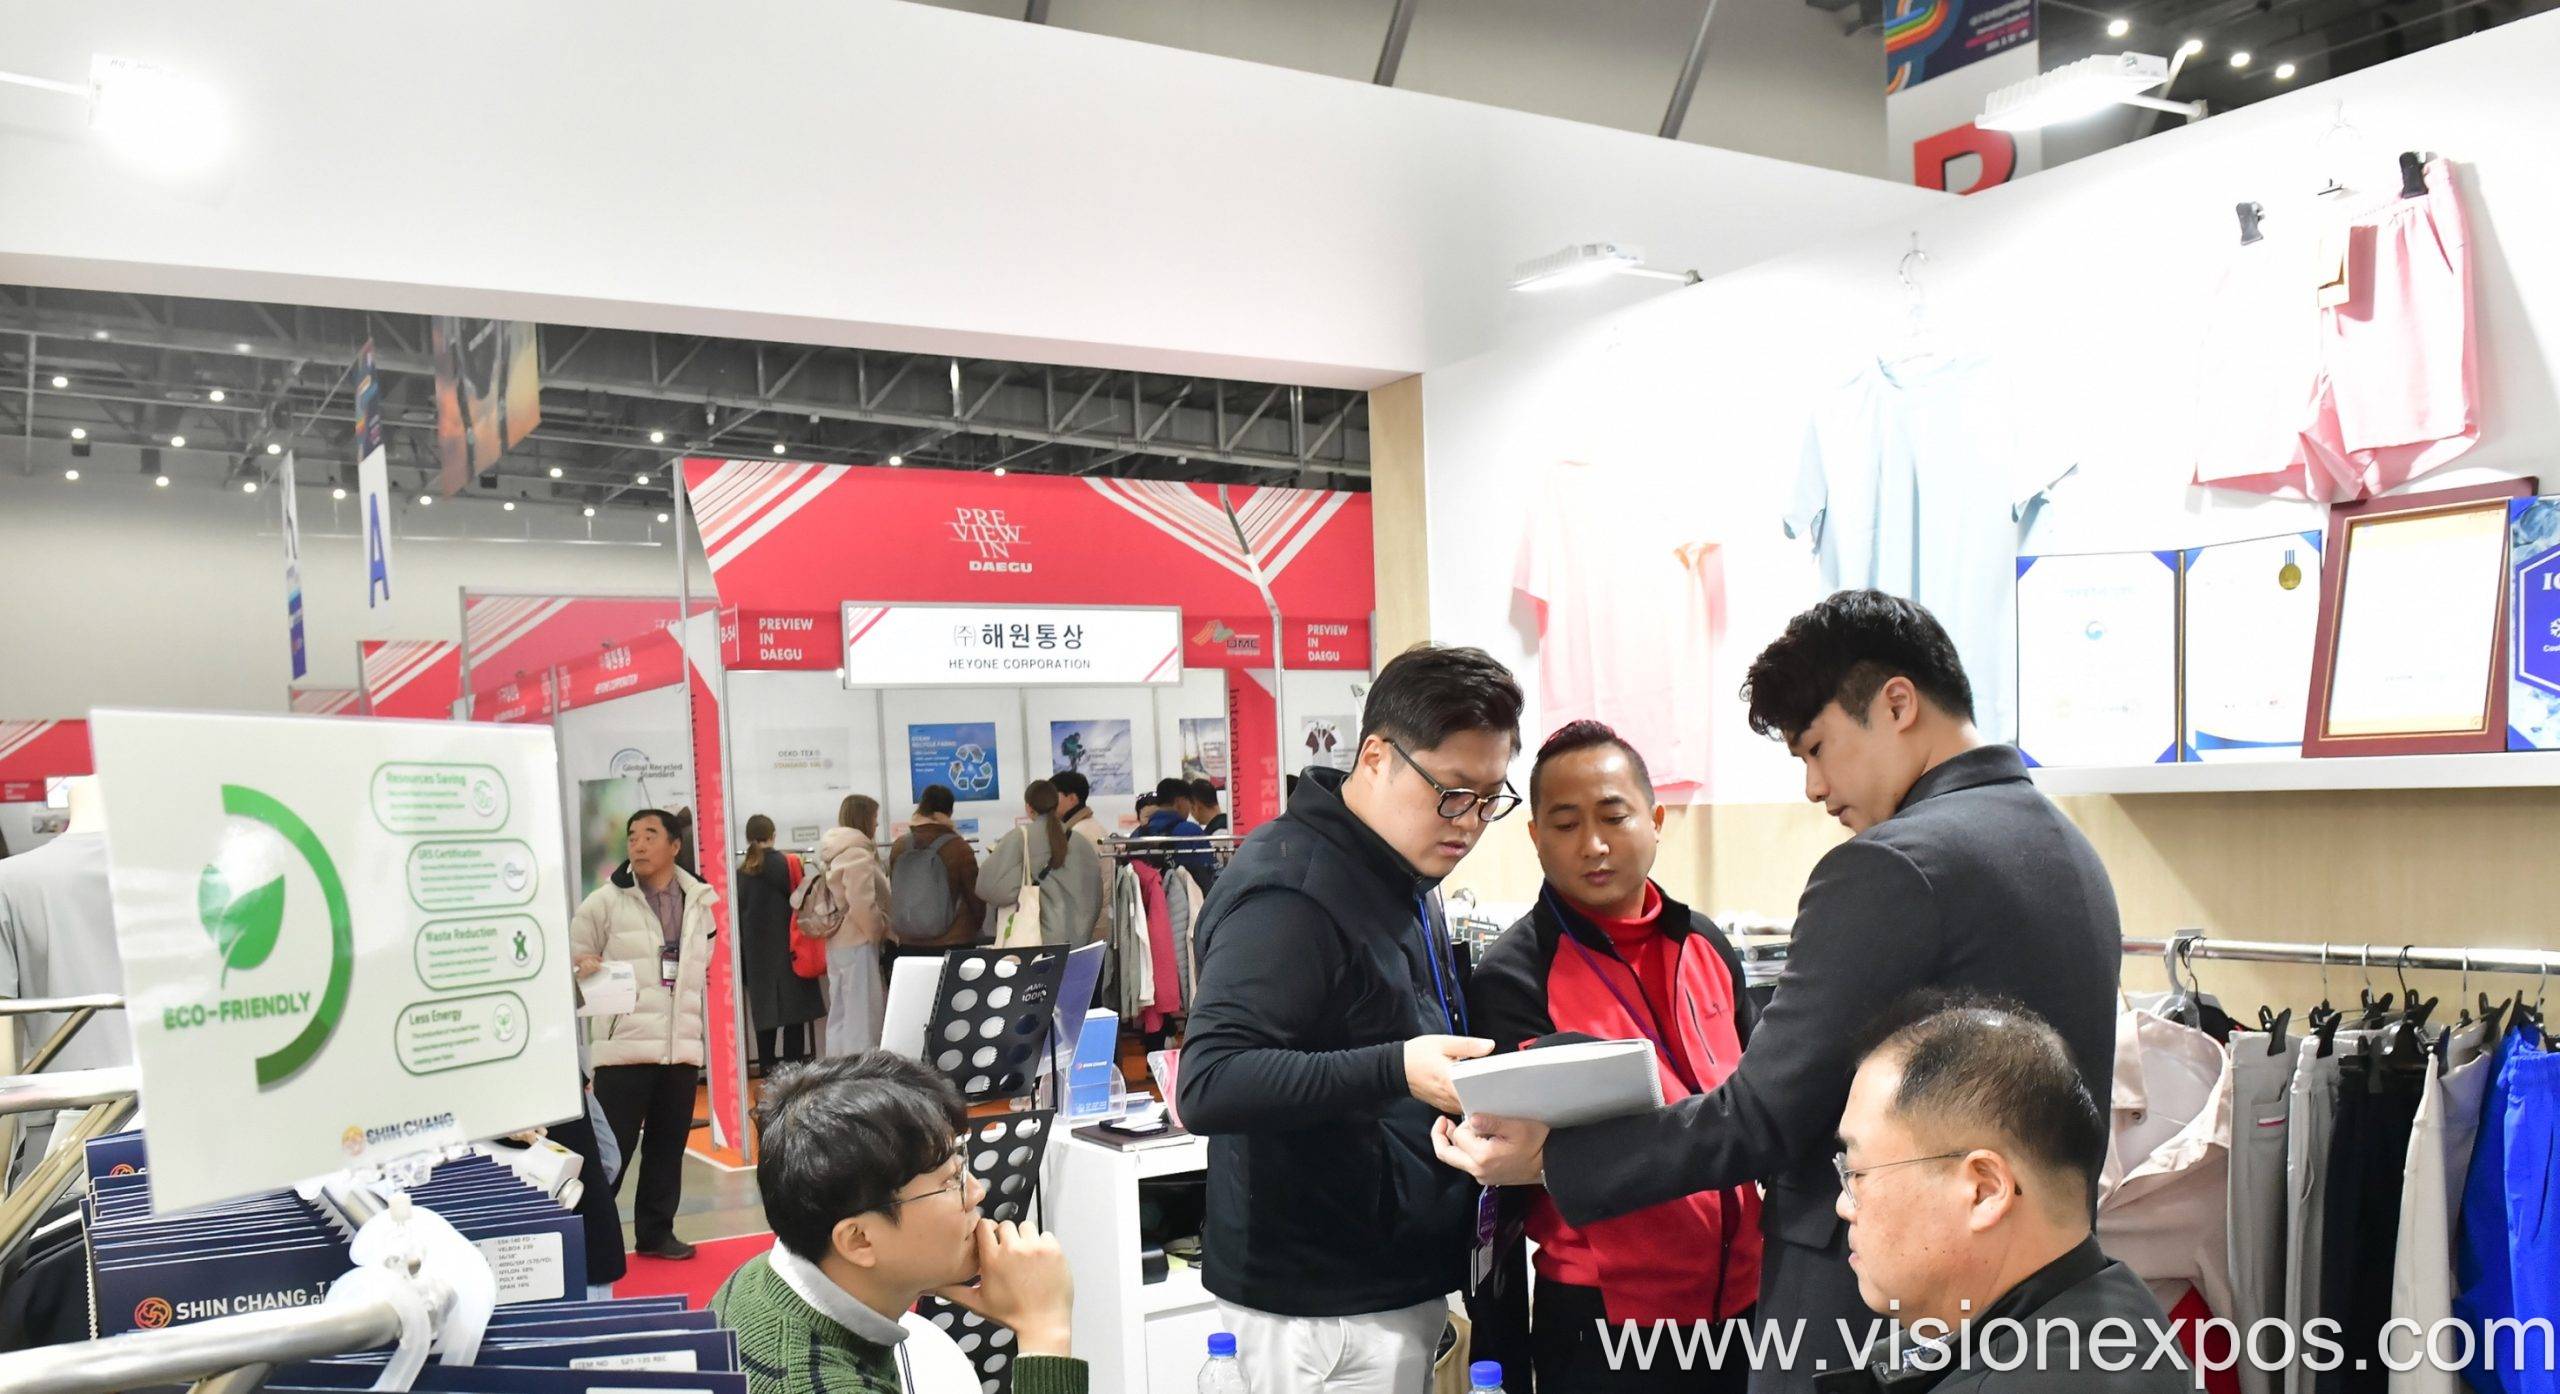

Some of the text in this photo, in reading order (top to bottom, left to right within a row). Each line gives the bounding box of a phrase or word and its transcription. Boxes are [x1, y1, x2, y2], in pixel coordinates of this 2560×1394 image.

[955, 507, 1006, 528] PRE
[951, 523, 1021, 543] VIEW
[369, 492, 390, 609] A
[978, 541, 1010, 558] IN
[968, 560, 1033, 573] DAEGU
[758, 618, 814, 631] PREVIEW
[1306, 623, 1349, 636] PREVIEW
[758, 632, 774, 645] IN
[1306, 637, 1319, 648] IN
[759, 648, 803, 661] DAEGU
[1307, 651, 1340, 662] DAEGU
[948, 658, 1091, 670] HEYONE CORPORATION
[1231, 687, 1241, 828] International
[622, 762, 683, 773] Global Recycled
[640, 770, 675, 779] Standard
[385, 772, 467, 787] Resources Saving
[435, 848, 482, 860] Certification
[424, 927, 498, 943] Waste Reduction
[162, 991, 311, 1031] ECO-FRIENDLY
[408, 1008, 462, 1025] Less Energy
[366, 1112, 456, 1145] SHIN CHANG
[176, 1288, 307, 1321] SHIN CHANG
